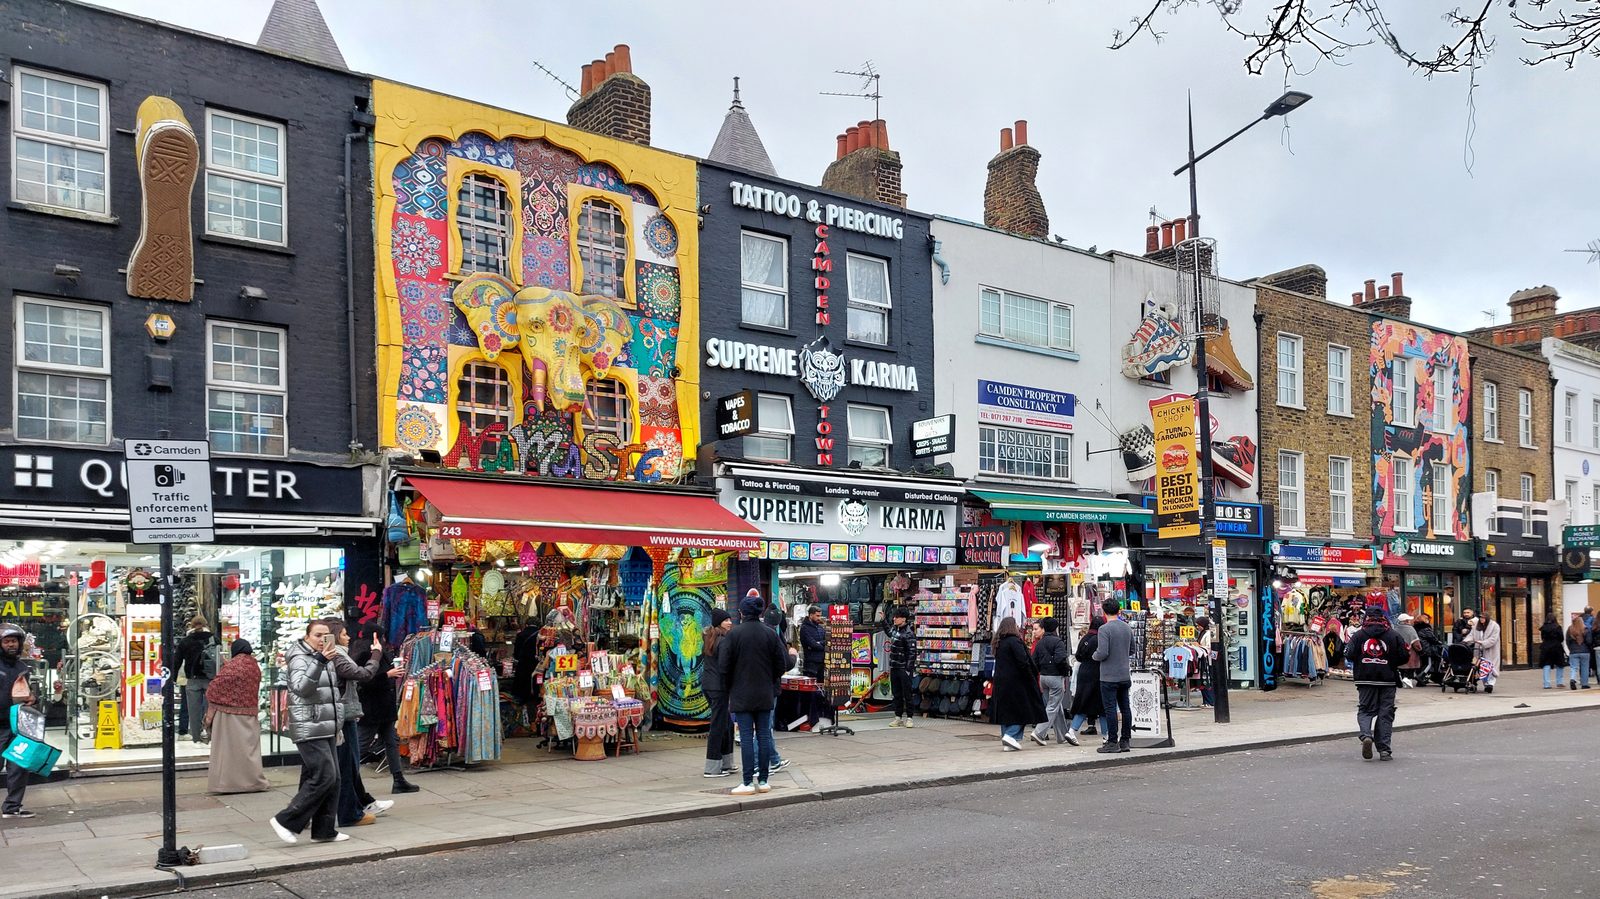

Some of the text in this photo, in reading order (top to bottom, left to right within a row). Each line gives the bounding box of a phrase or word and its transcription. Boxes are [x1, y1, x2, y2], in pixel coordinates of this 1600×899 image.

[730, 181, 904, 240] TATTOO & PIERCING
[812, 224, 832, 326] CAMDEN
[706, 337, 919, 392] SUPREME KARMA
[987, 383, 1067, 404] CAMDEN PROPERTY
[725, 396, 745, 410] VAPES
[997, 396, 1058, 413] CONSULTANCY
[732, 410, 738, 421] &
[1157, 404, 1191, 418] CHICKEN
[1163, 413, 1184, 424] SHOP
[721, 418, 750, 435] TOBACCO
[1165, 426, 1183, 435] TURN
[815, 405, 834, 466] TOWN
[999, 430, 1051, 448] ESTATE
[1161, 431, 1188, 442] AROUND
[153, 445, 201, 455] Camden
[999, 445, 1051, 462] AGENTS
[80, 459, 302, 500] QTER
[741, 479, 763, 488] Tattoo
[772, 482, 800, 492] Piercing
[1161, 473, 1193, 487] BEST
[152, 492, 190, 501] Traffic
[825, 486, 880, 497] London Souvenir
[904, 492, 958, 503] Disturbed Clothing
[1161, 486, 1193, 498] FRIED
[1162, 496, 1194, 505] CHICKEN
[1170, 503, 1194, 511] LONDON
[136, 502, 208, 514] enforcement
[736, 496, 946, 531] SUPREME KARMA
[1215, 505, 1252, 520] HOES
[149, 514, 197, 524] cameras
[148, 532, 200, 540] camden.gov.uk
[442, 526, 462, 537] 243
[650, 535, 760, 549] WWW.NAMASTECAMDEN.UK
[959, 531, 1005, 547] TATTOO
[1410, 543, 1455, 556] STARBUCKS
[0, 601, 44, 616] ALE
[277, 606, 319, 618] SALE
[1035, 606, 1049, 616] £1
[1181, 627, 1194, 637] £15
[558, 657, 573, 668] £1
